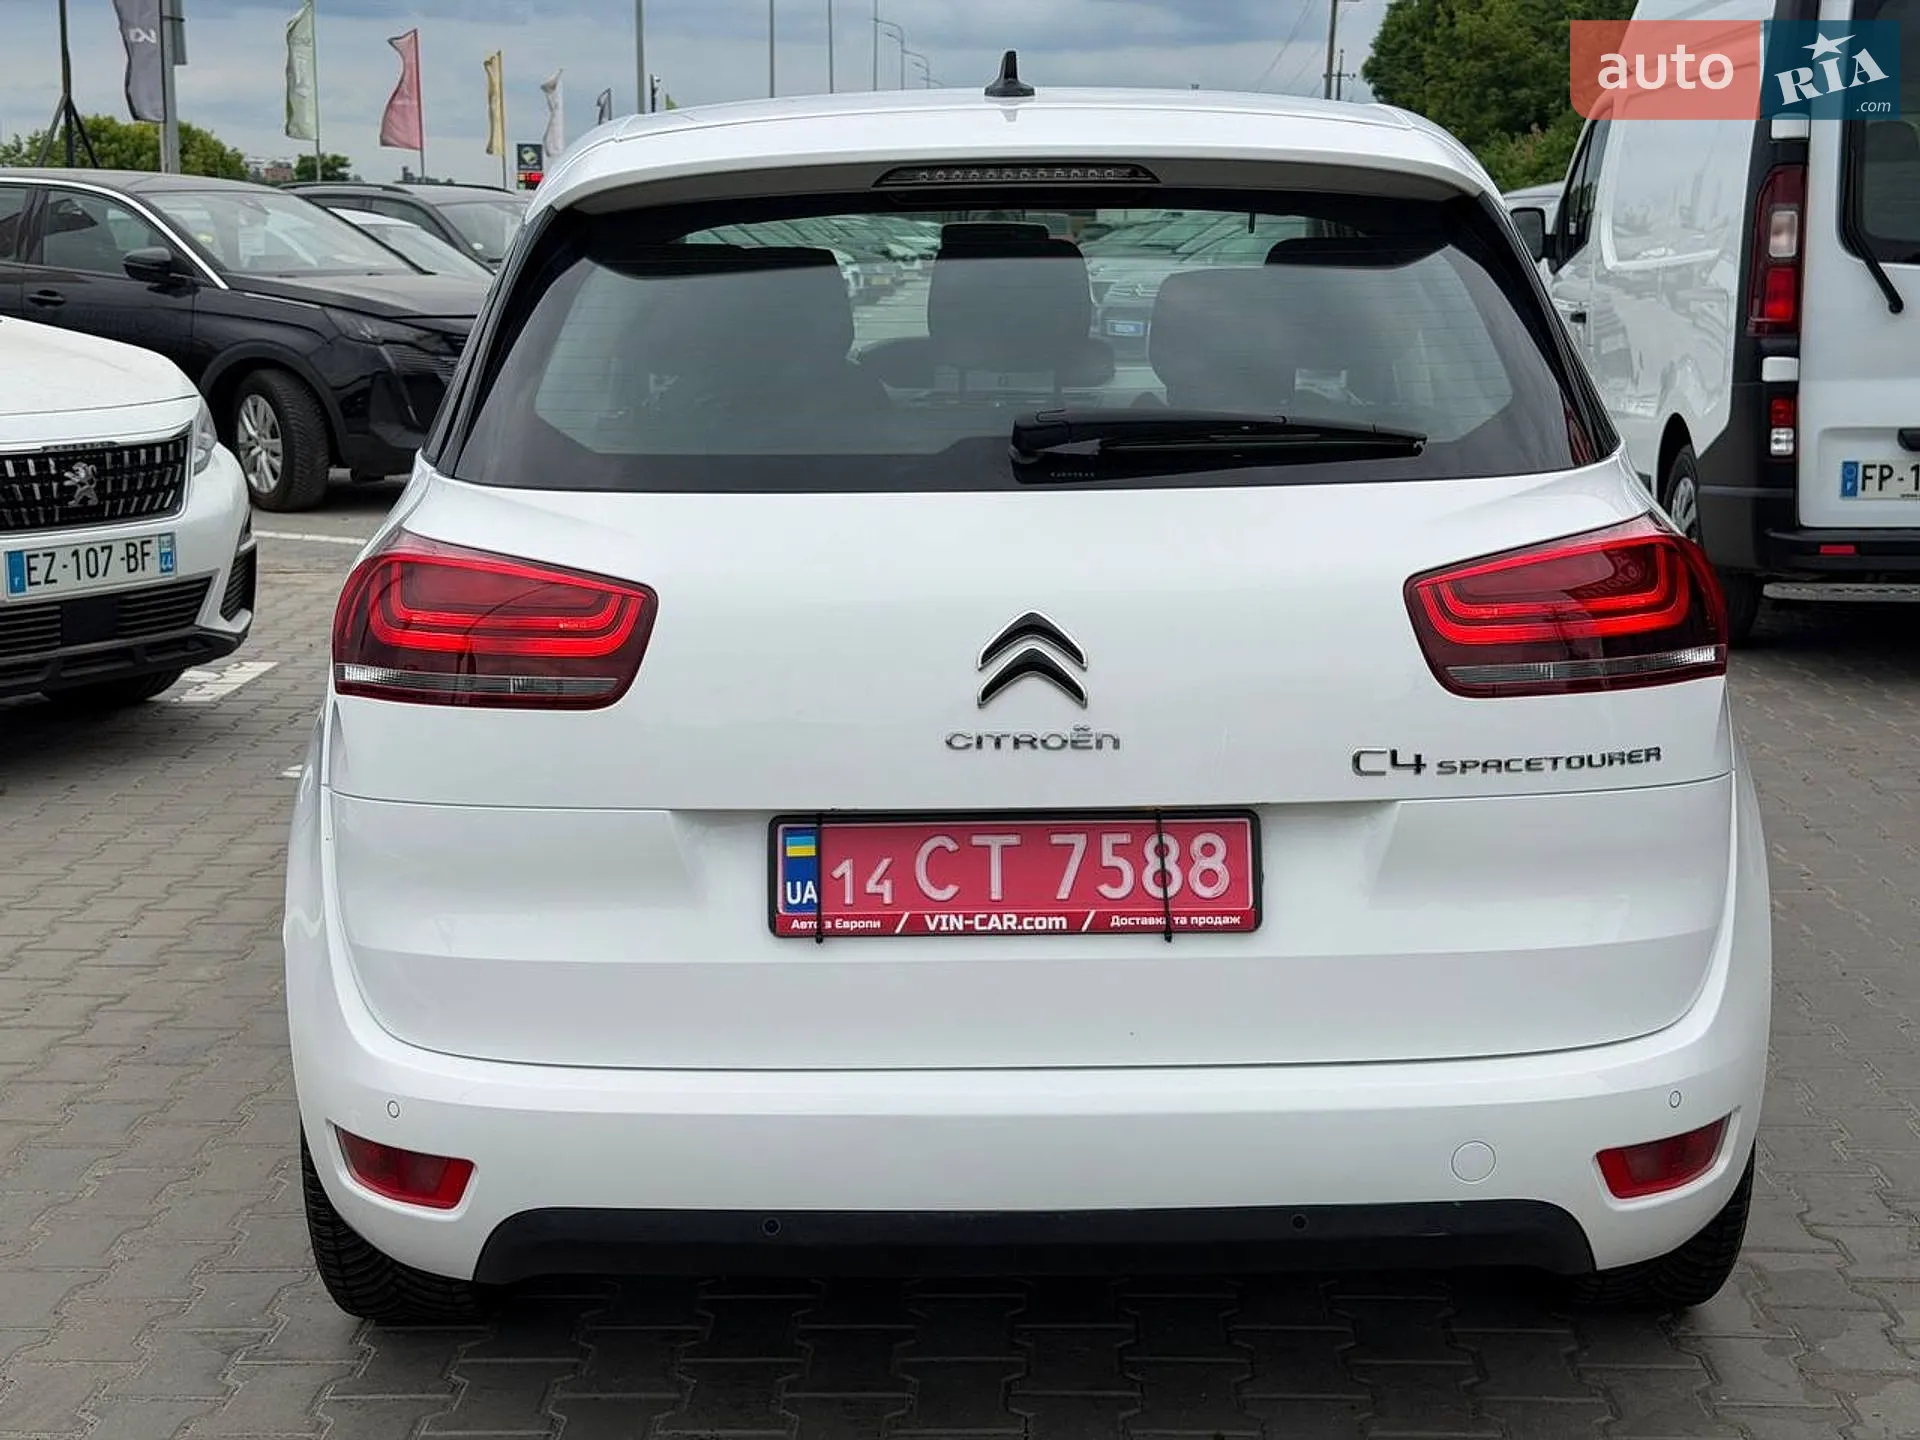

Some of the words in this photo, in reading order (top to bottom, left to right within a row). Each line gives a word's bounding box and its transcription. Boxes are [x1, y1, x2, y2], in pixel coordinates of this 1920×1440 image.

[1352, 748, 1427, 777] C4
[1436, 746, 1662, 776] SPACETOURER
[785, 880, 819, 905] UA
[831, 858, 893, 905] 14
[914, 834, 1022, 902] CT
[1050, 832, 1231, 901] 7588
[924, 912, 1068, 931] VIN-CAR.com
[1173, 915, 1188, 926] та
[1190, 913, 1241, 927] продаж
